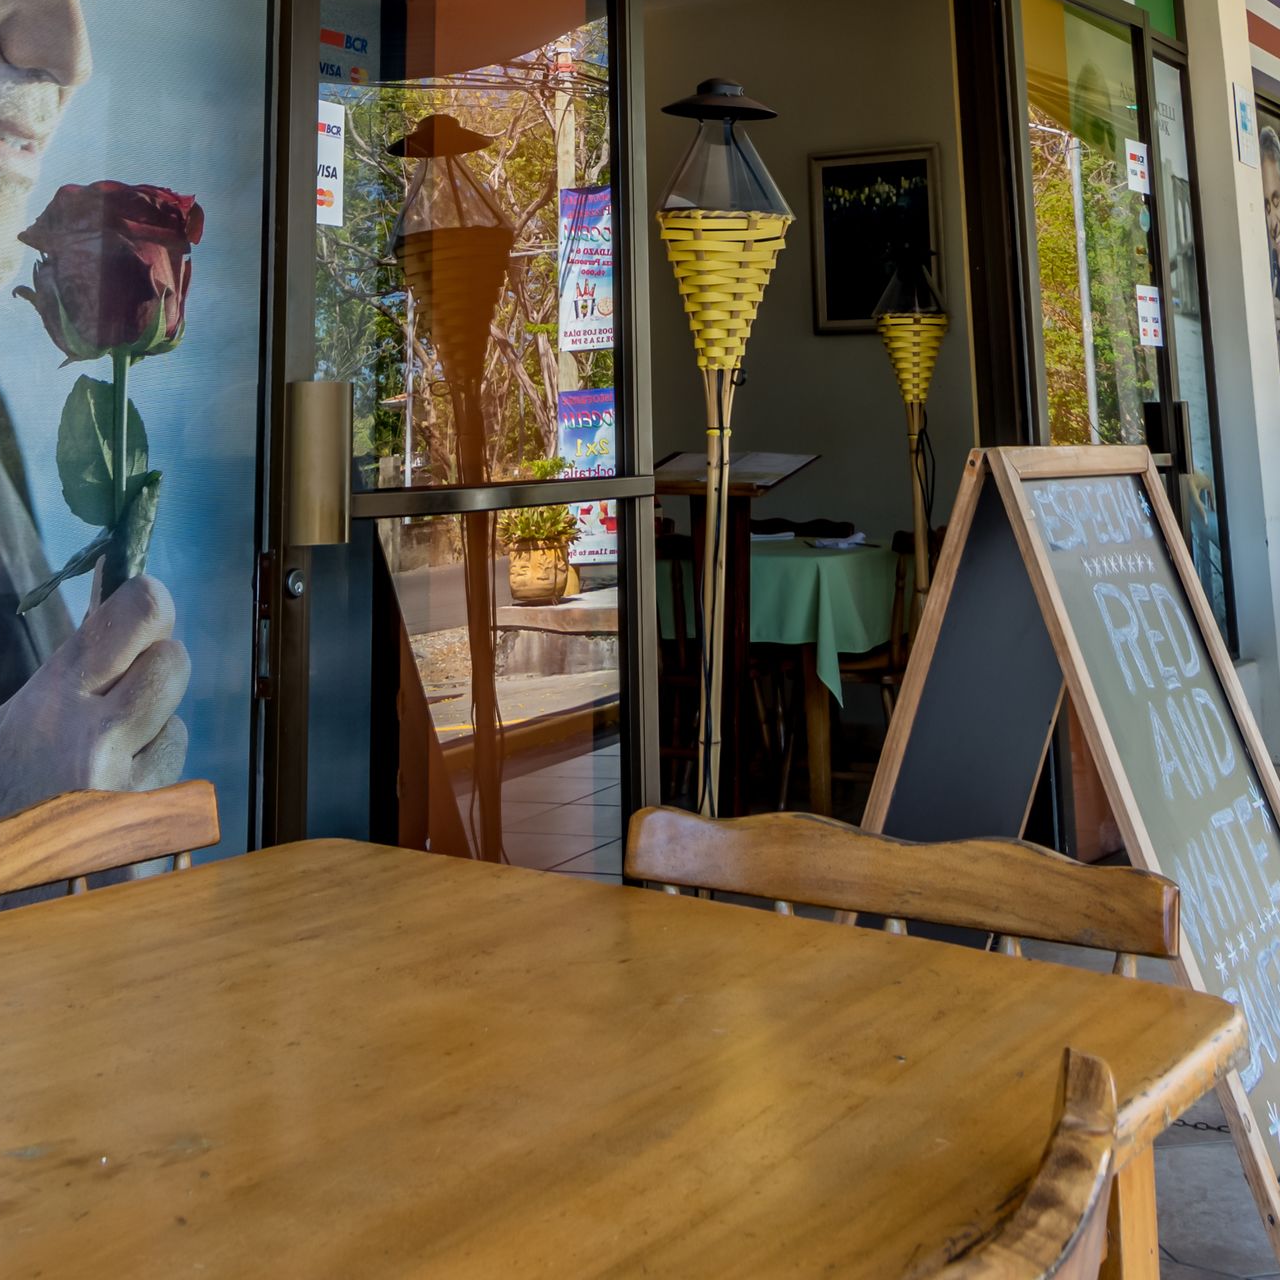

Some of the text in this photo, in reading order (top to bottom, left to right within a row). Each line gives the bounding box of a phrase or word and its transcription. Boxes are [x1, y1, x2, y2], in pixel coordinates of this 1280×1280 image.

[345, 34, 368, 55] BCR
[319, 61, 341, 78] VISA
[326, 124, 341, 136] BCR
[1093, 582, 1200, 696] RED
[1147, 687, 1235, 801] AND
